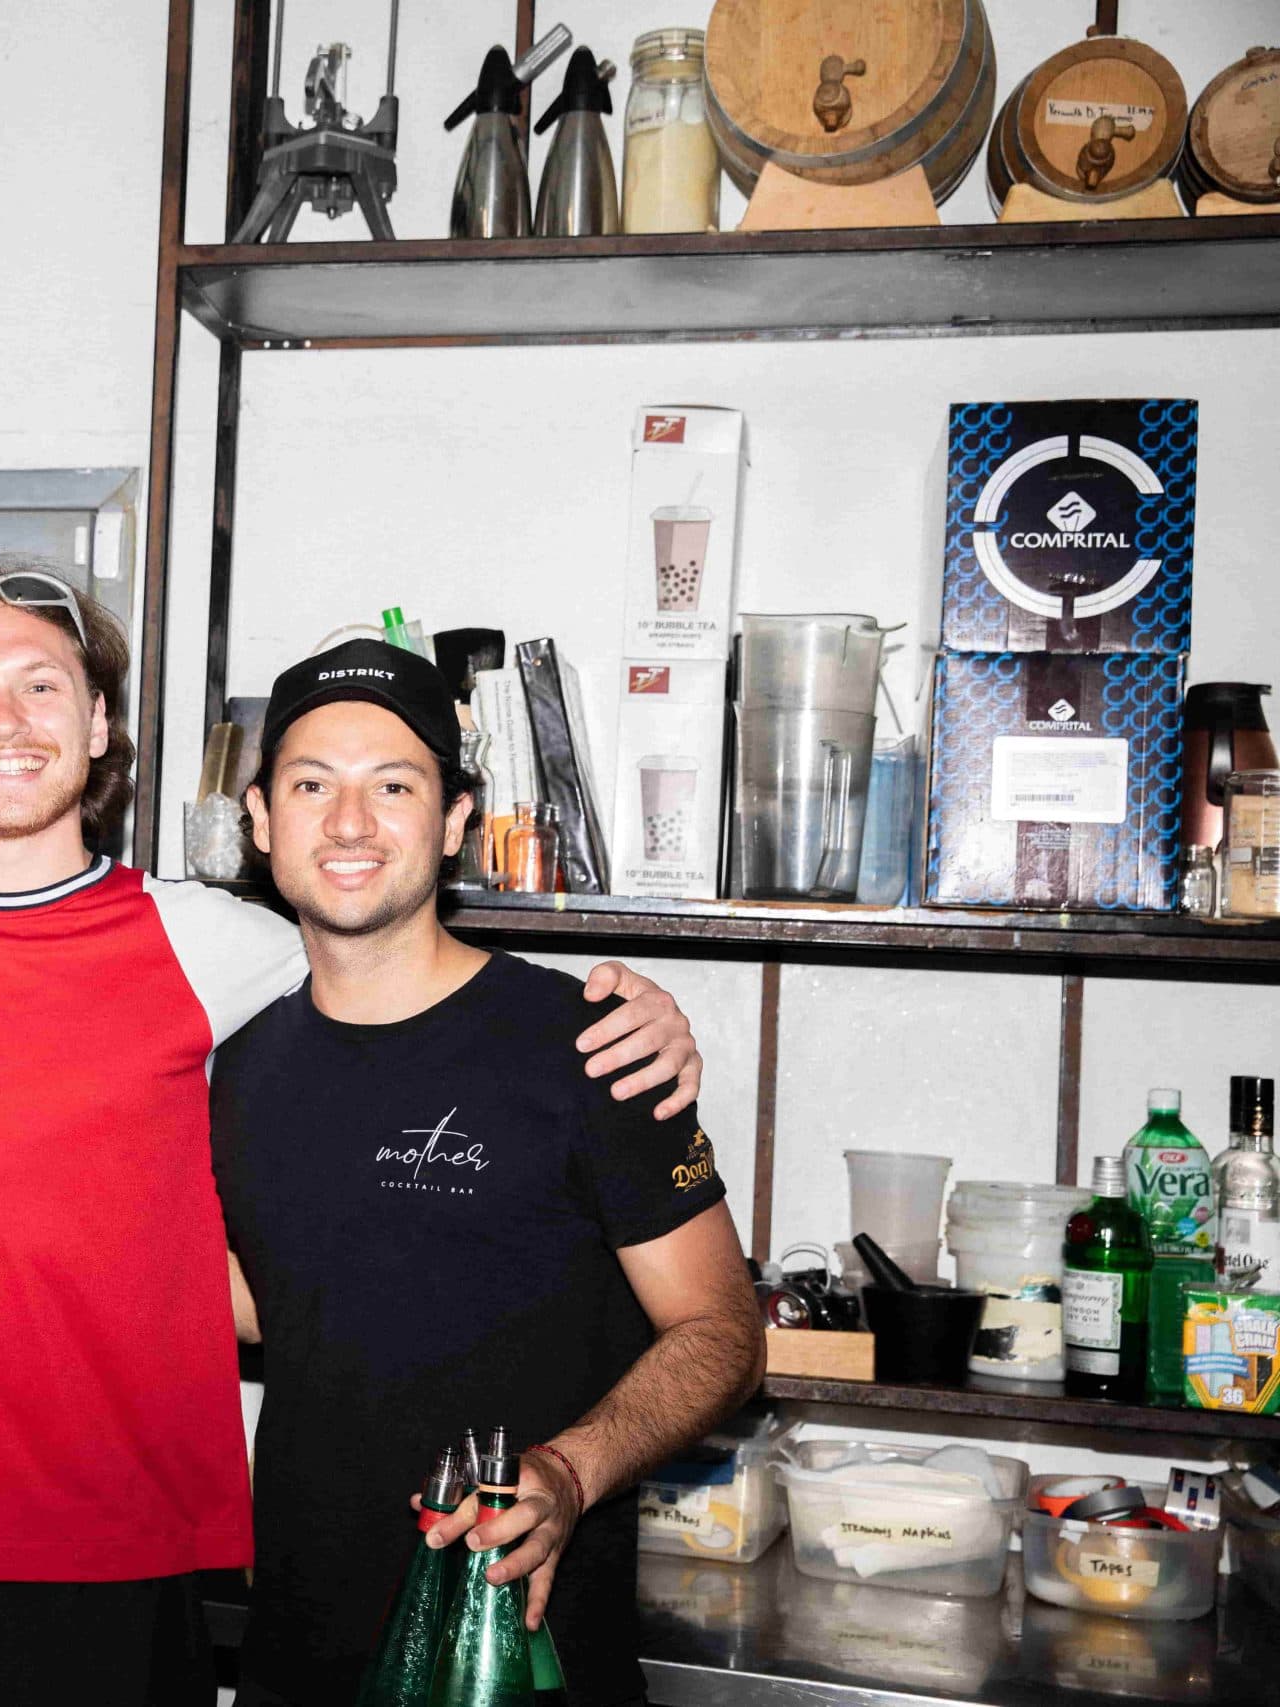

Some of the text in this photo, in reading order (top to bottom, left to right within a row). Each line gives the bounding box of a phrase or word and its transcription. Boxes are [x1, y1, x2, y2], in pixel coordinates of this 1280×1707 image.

[1010, 532, 1131, 548] COMPRITAL
[697, 621, 716, 630] TEA
[318, 668, 395, 681] DISTRIKT
[1029, 721, 1093, 732] COMPRITAL
[685, 872, 704, 881] TEA
[375, 1106, 490, 1180] mother
[380, 1180, 475, 1195] COCKTAIL BAR
[1134, 1163, 1210, 1197] Vera
[1222, 1387, 1244, 1405] 36
